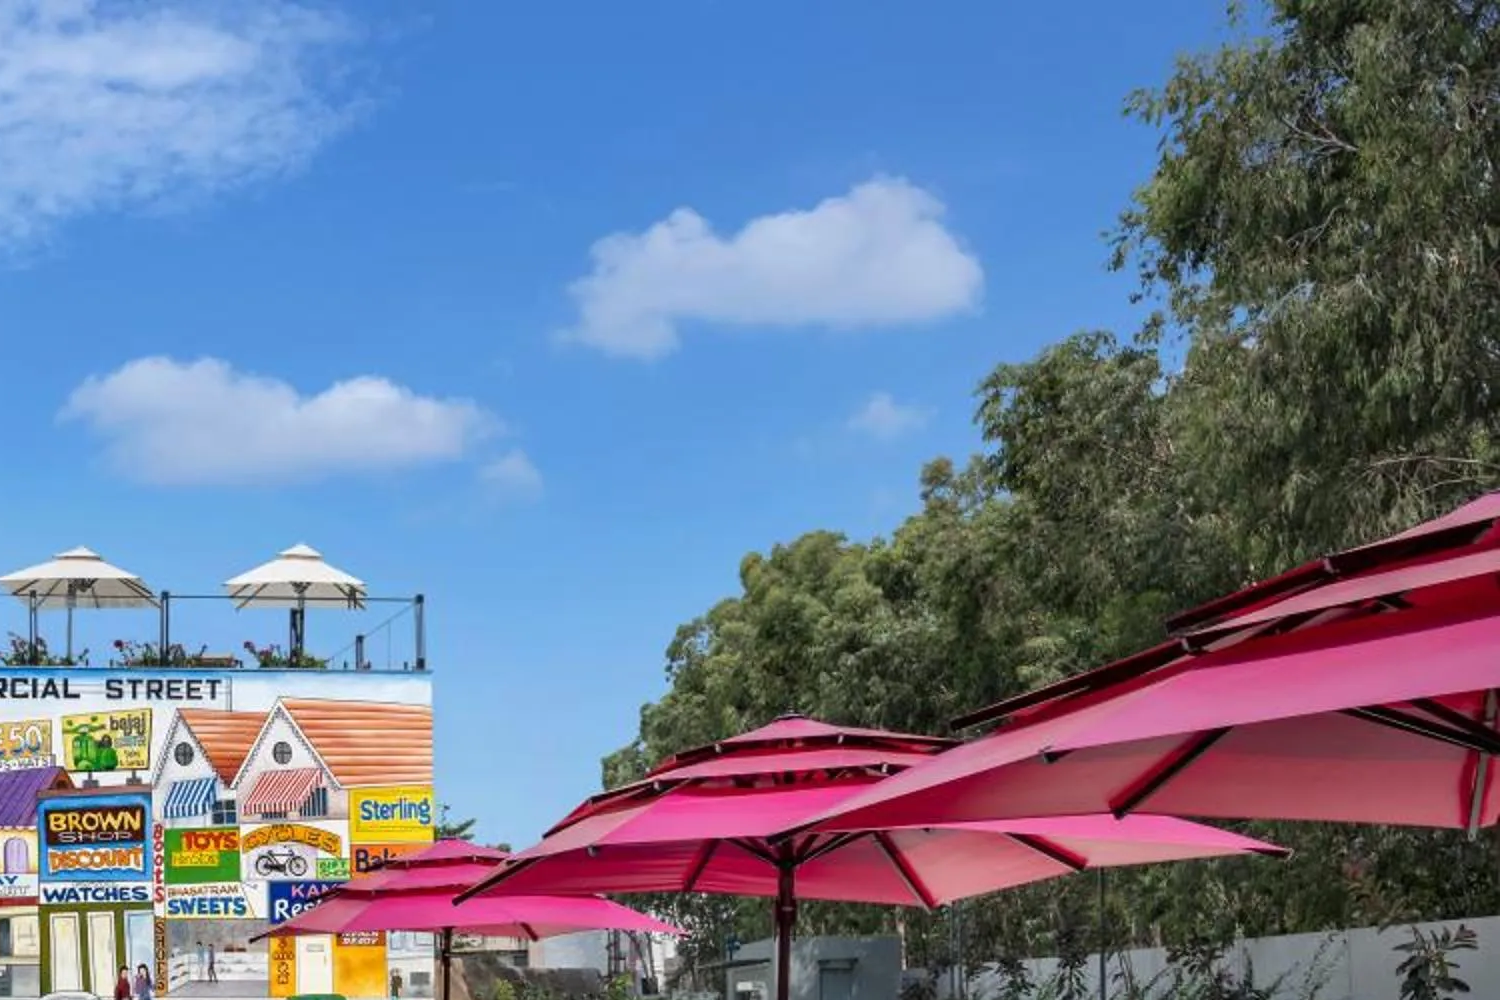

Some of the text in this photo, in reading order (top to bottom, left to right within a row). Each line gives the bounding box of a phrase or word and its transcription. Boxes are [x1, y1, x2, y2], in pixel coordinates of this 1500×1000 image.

[105, 679, 222, 700] STREET
[9, 725, 43, 753] 50
[49, 810, 141, 832] BROWN
[360, 797, 431, 825] Sterling
[58, 831, 132, 843] SHOP
[184, 831, 239, 850] TOYS
[49, 847, 143, 871] DISCOUNT
[43, 886, 149, 902] WATCHES
[168, 897, 247, 916] SWEETS
[274, 898, 324, 920] Res
